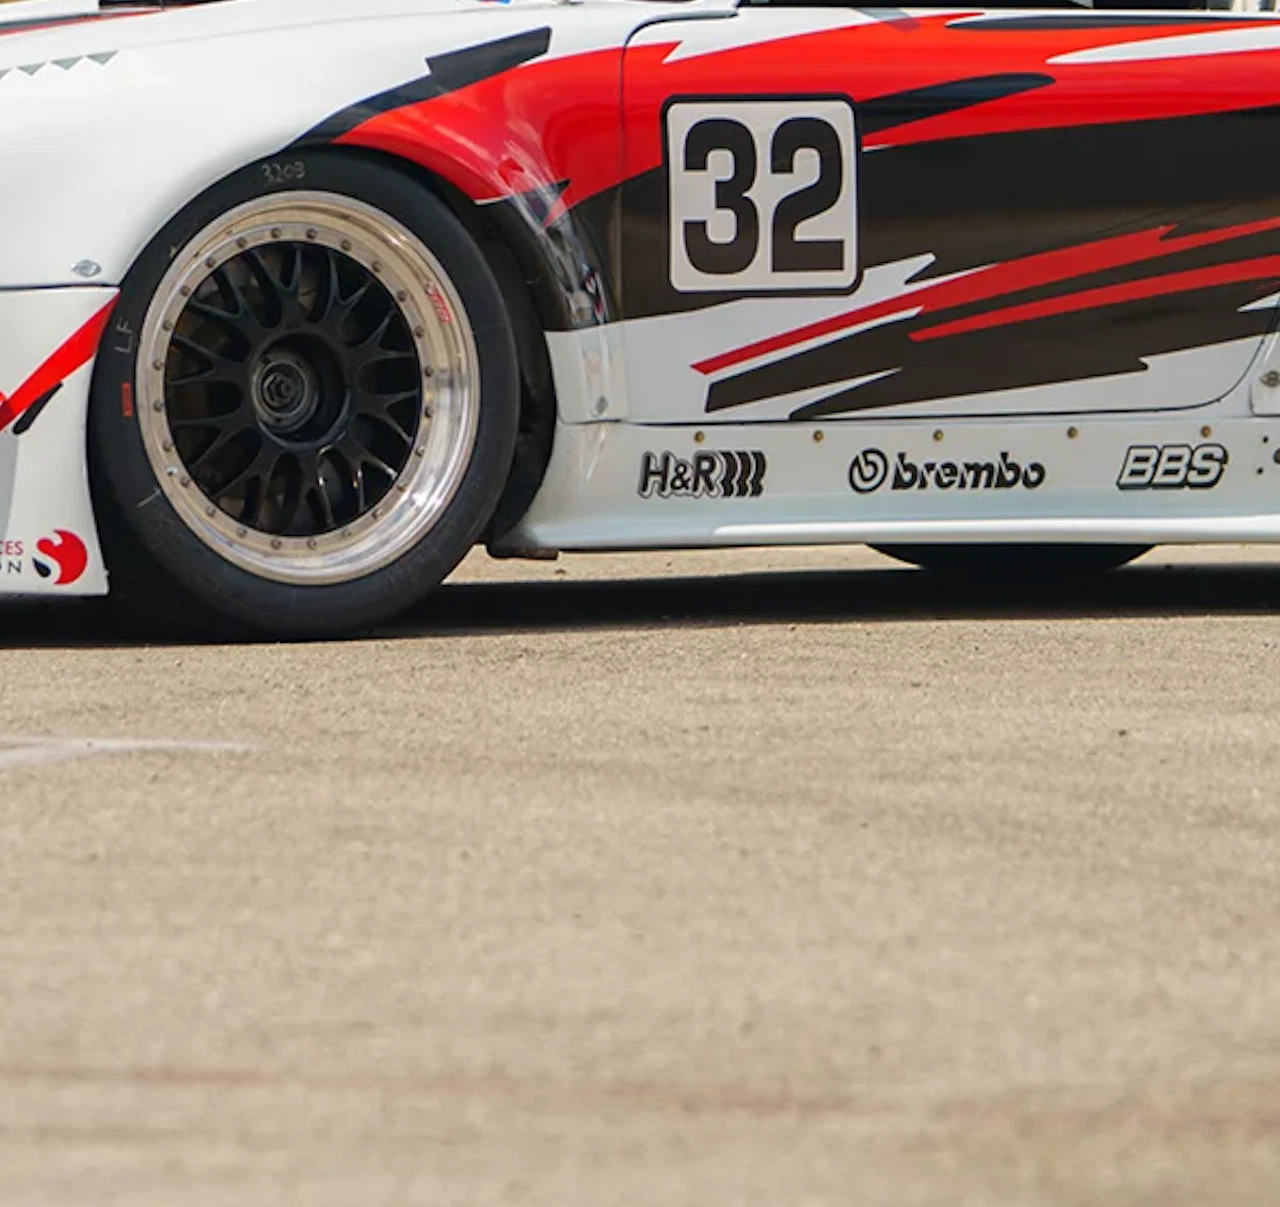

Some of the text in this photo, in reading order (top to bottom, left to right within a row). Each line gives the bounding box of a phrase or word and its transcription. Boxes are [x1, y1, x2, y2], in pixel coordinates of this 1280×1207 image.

[683, 116, 845, 275] 32
[638, 450, 723, 499] H&R
[891, 451, 1046, 490] brembo
[1116, 443, 1230, 490] BBS
